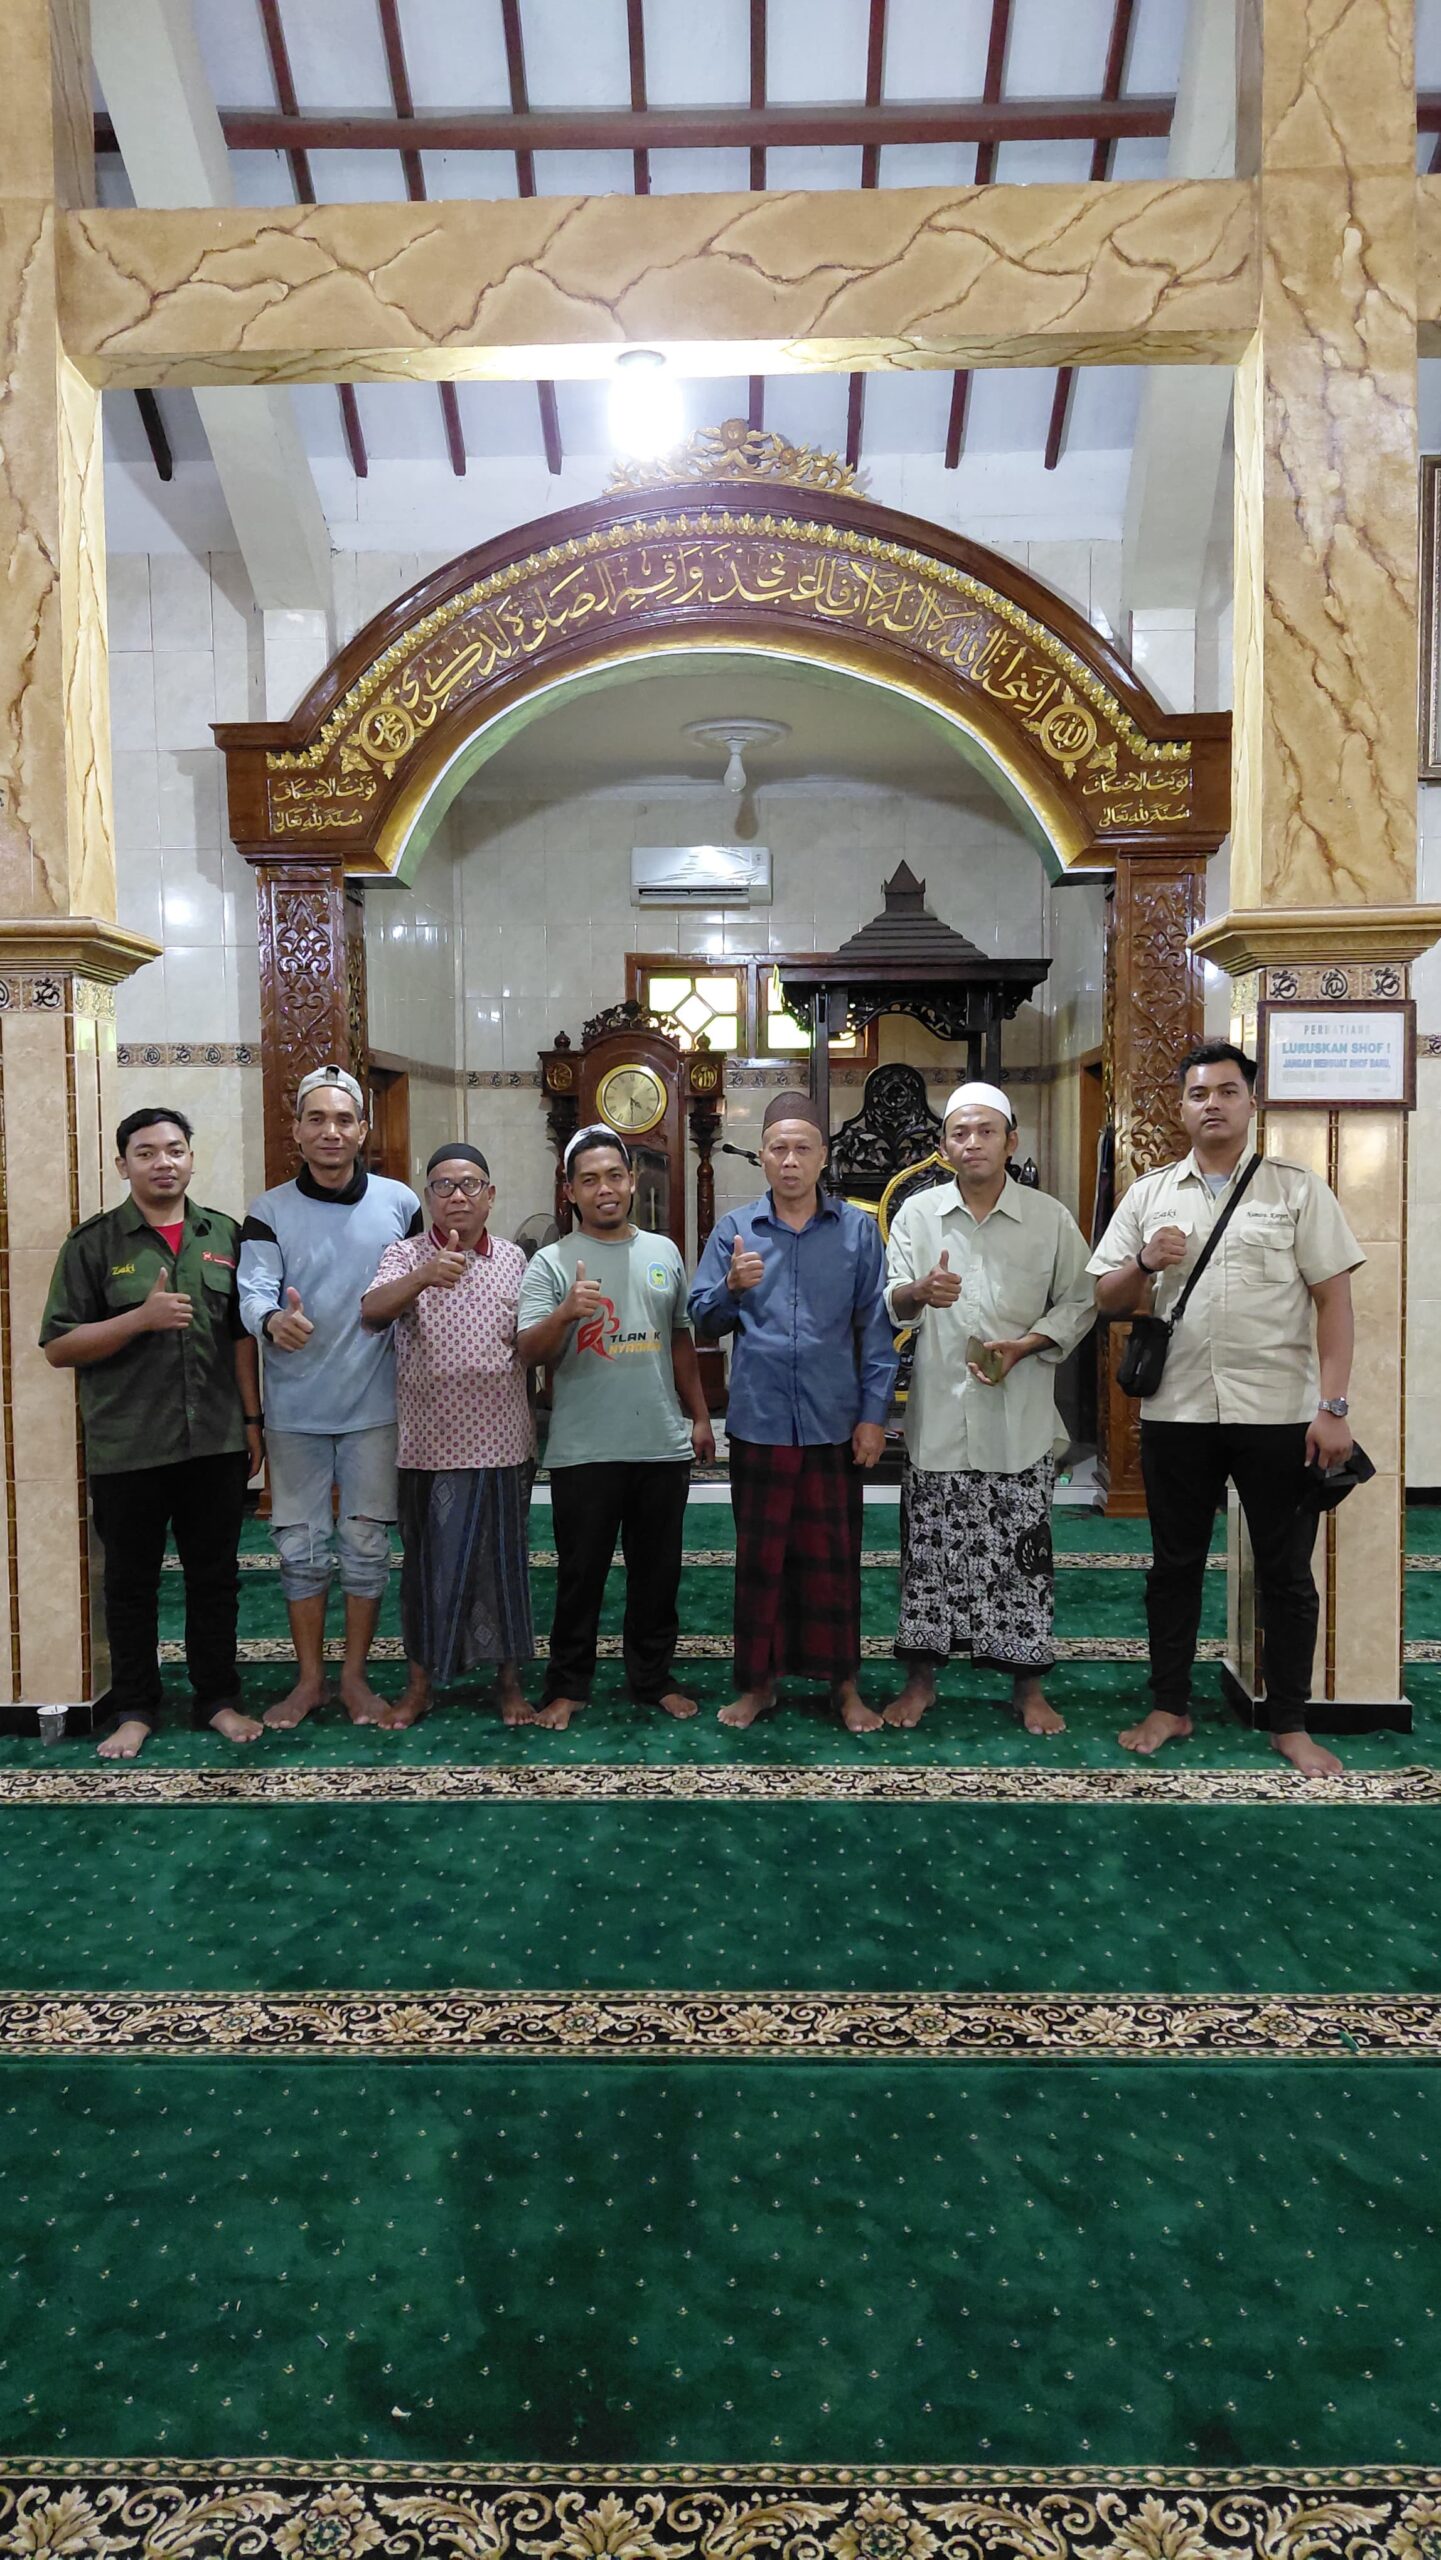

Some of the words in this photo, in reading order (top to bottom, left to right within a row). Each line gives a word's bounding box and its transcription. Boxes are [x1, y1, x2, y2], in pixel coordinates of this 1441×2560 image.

[1282, 1043, 1348, 1054] LURUSKAN
[1351, 1043, 1384, 1054] SHOF
[610, 1331, 661, 1343] TLANK
